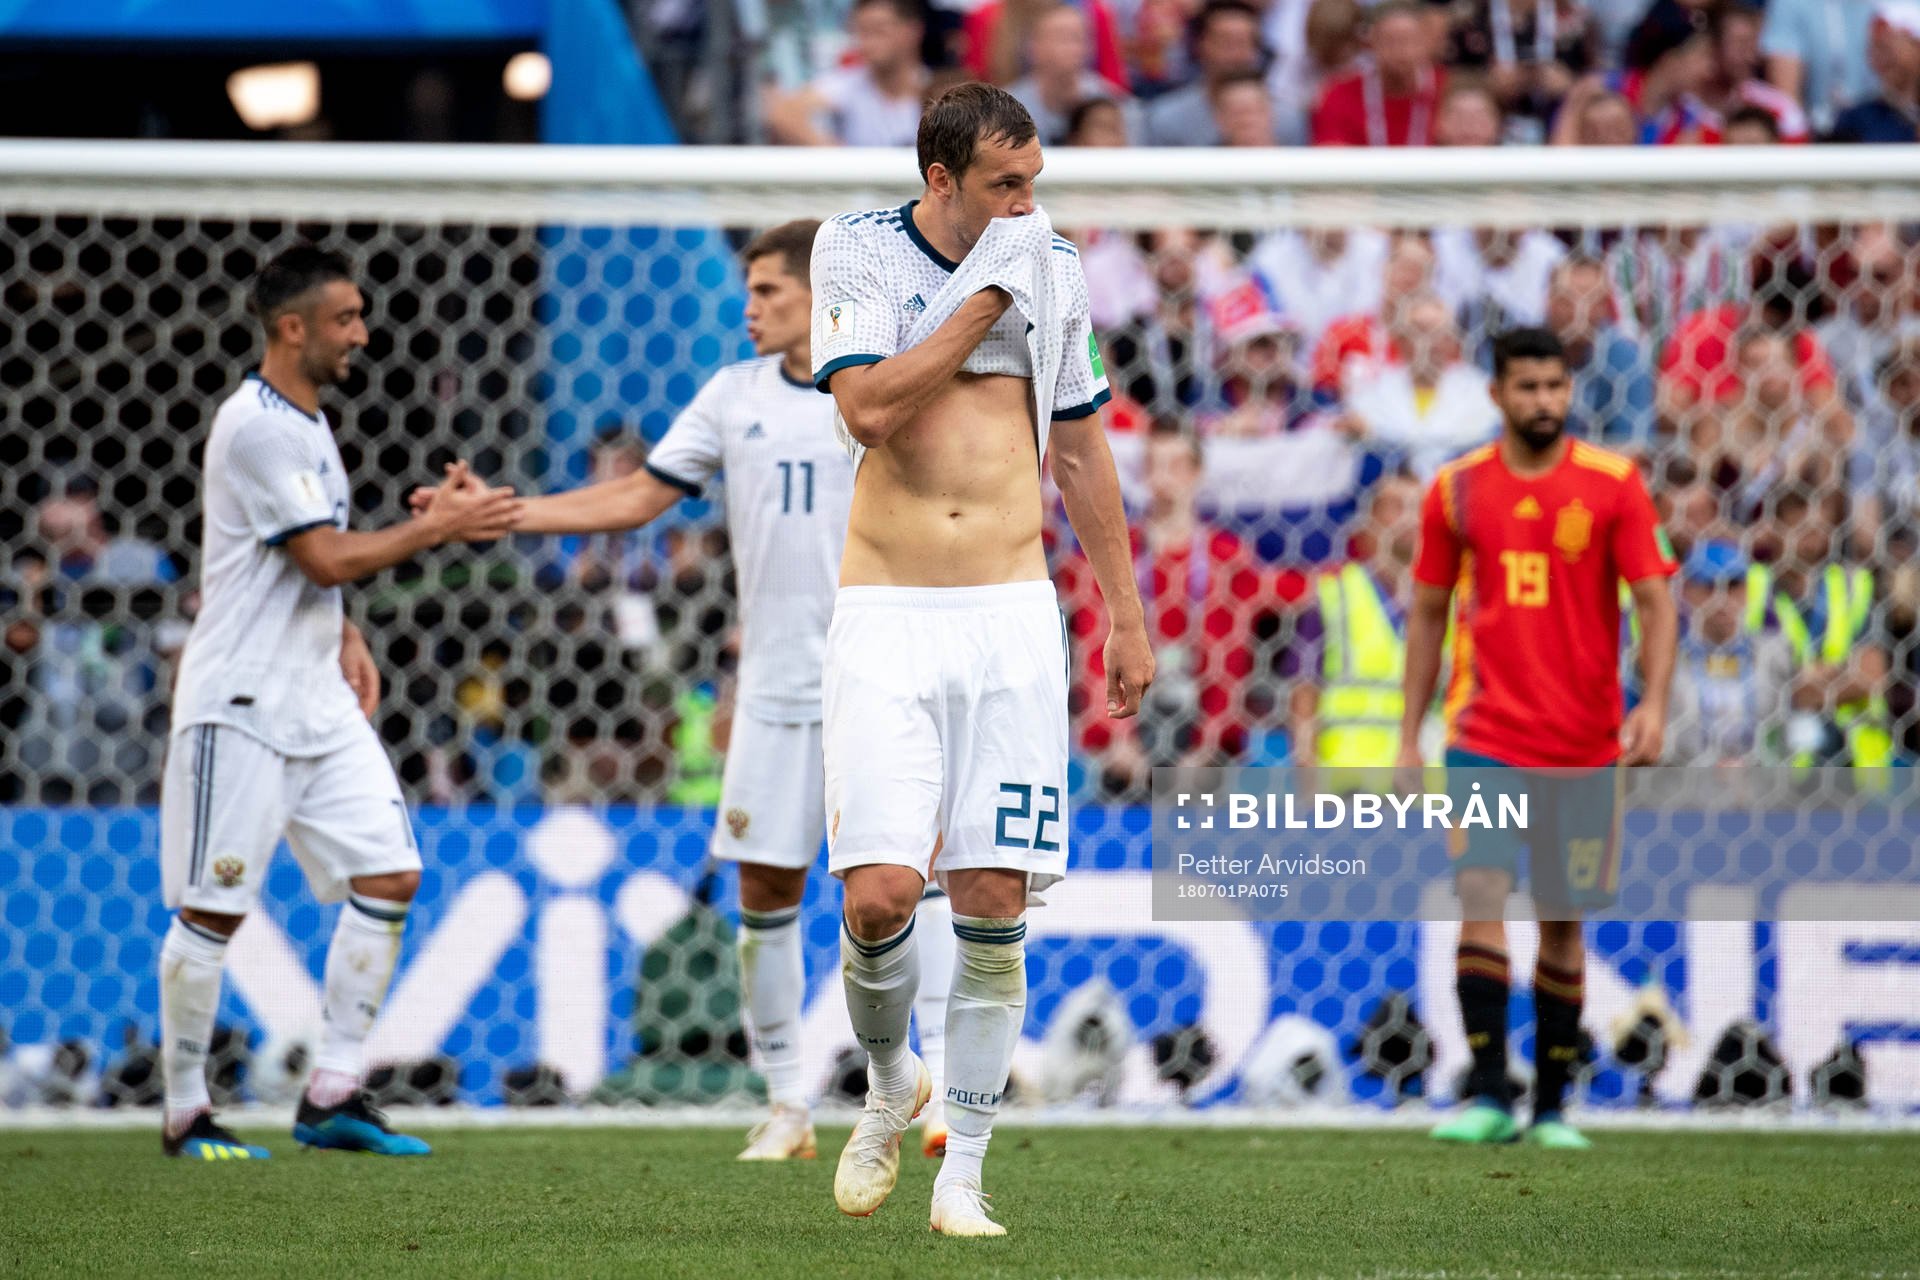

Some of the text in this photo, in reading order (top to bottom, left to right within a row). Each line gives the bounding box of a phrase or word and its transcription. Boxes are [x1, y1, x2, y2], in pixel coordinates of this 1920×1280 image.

[777, 461, 813, 514] 11
[1500, 550, 1549, 608] 19
[995, 782, 1060, 852] 22
